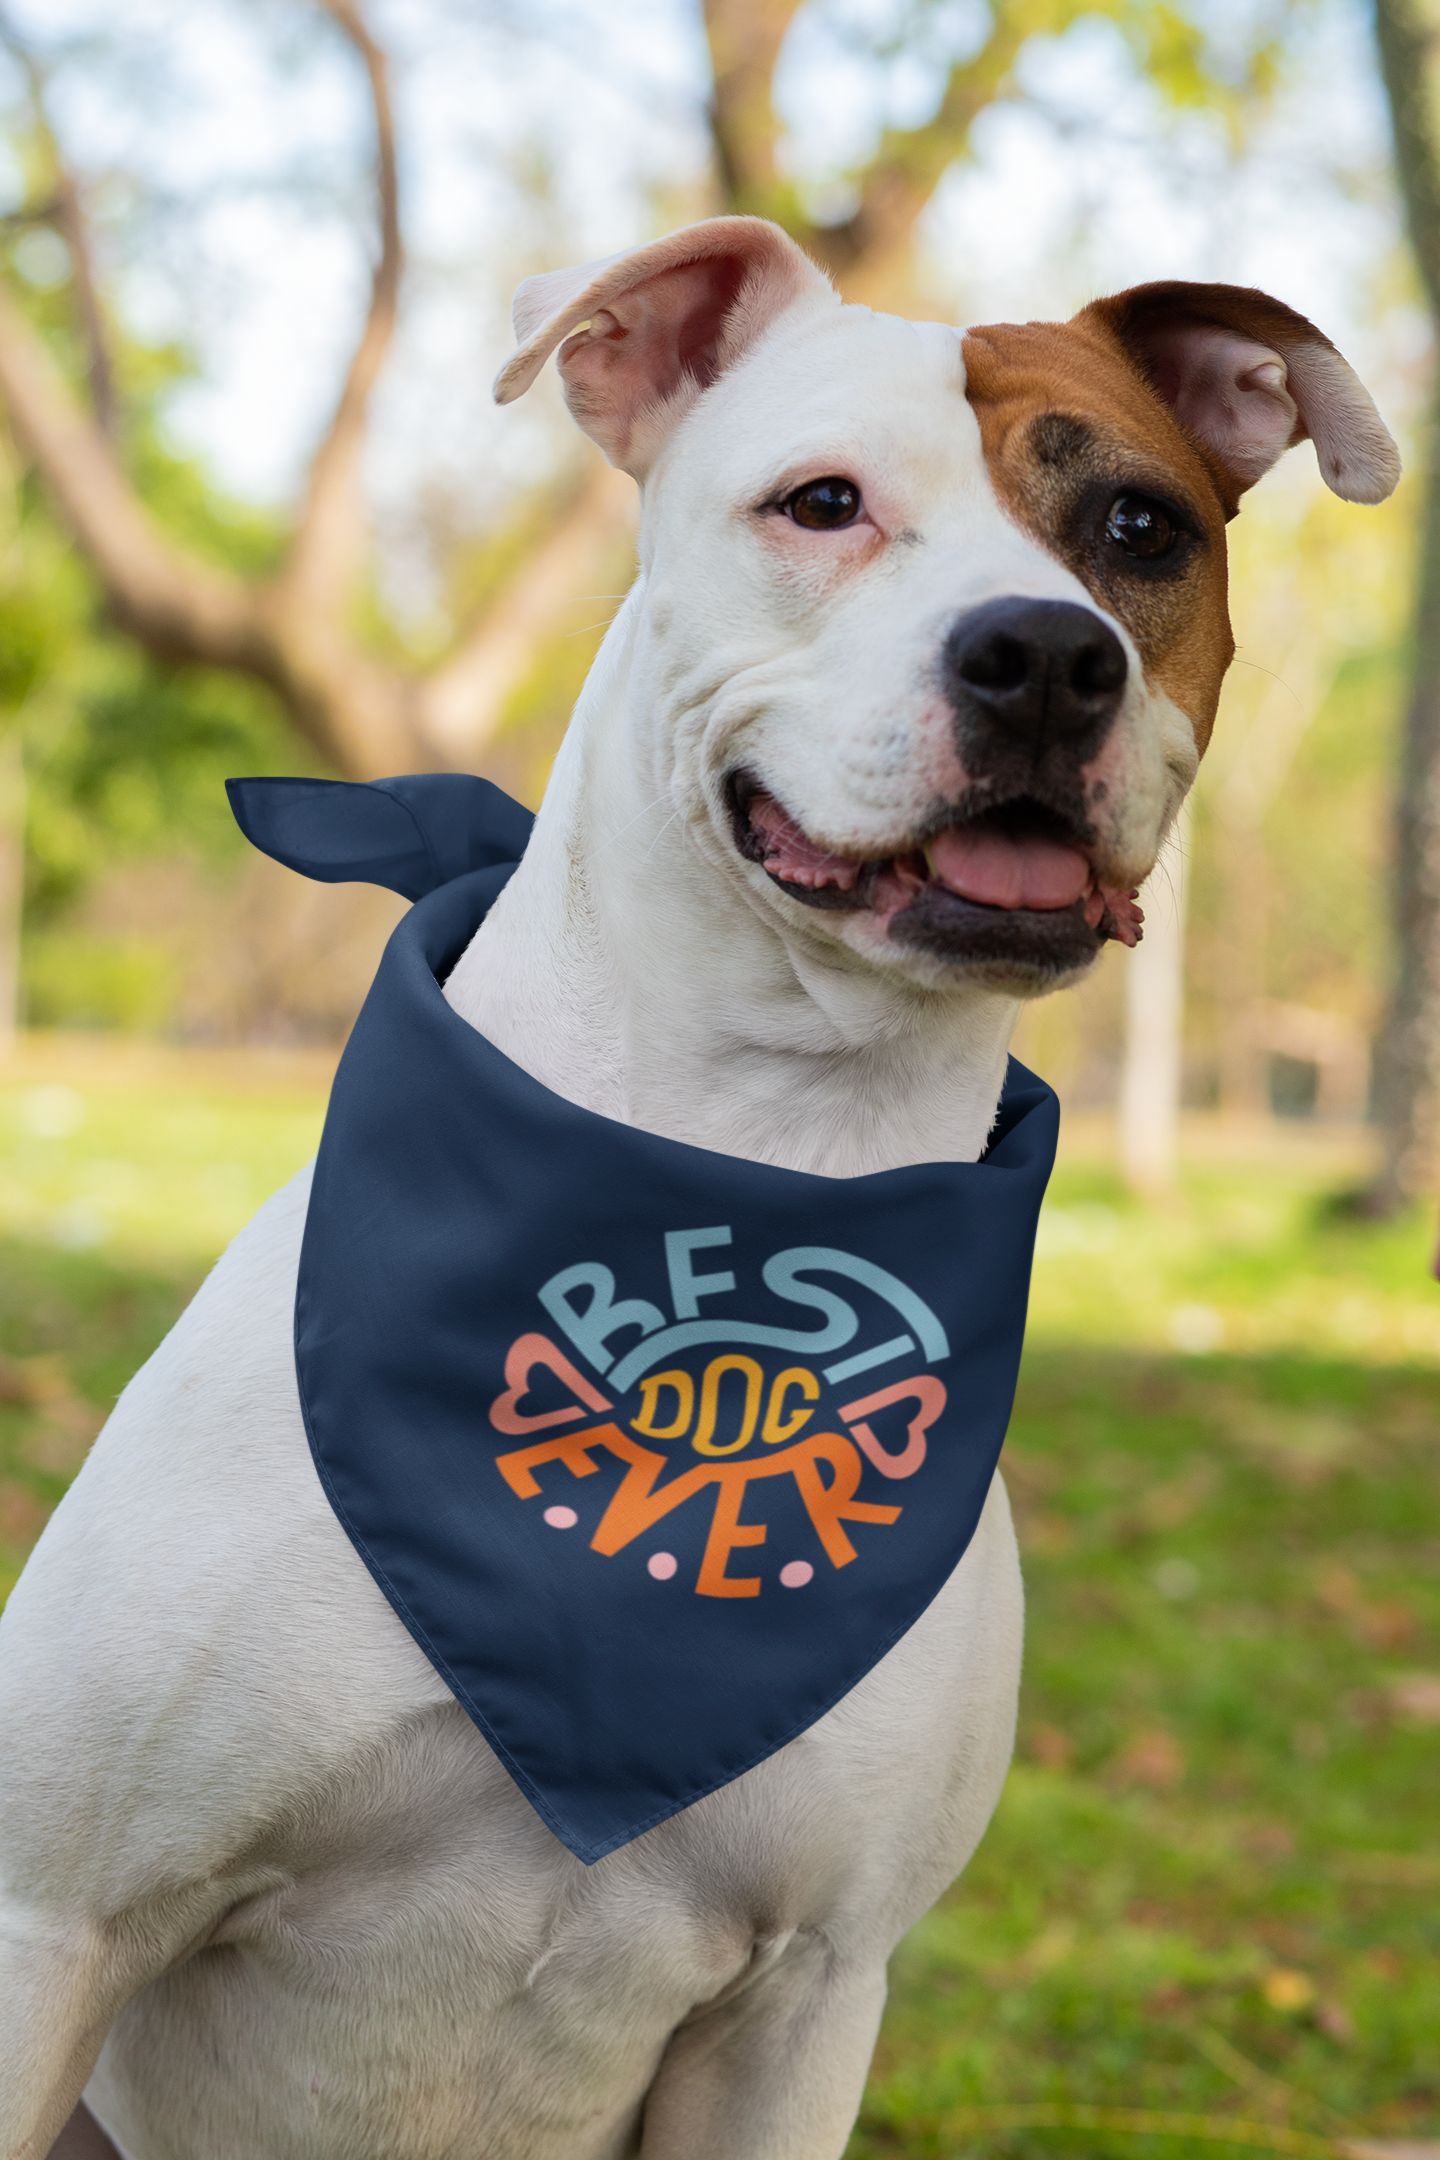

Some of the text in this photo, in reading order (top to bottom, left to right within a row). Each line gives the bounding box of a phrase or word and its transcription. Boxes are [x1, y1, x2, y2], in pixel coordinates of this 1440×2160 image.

[538, 1225, 950, 1394] BEST
[629, 1354, 820, 1457] DOG
[495, 1422, 903, 1598] EVER
